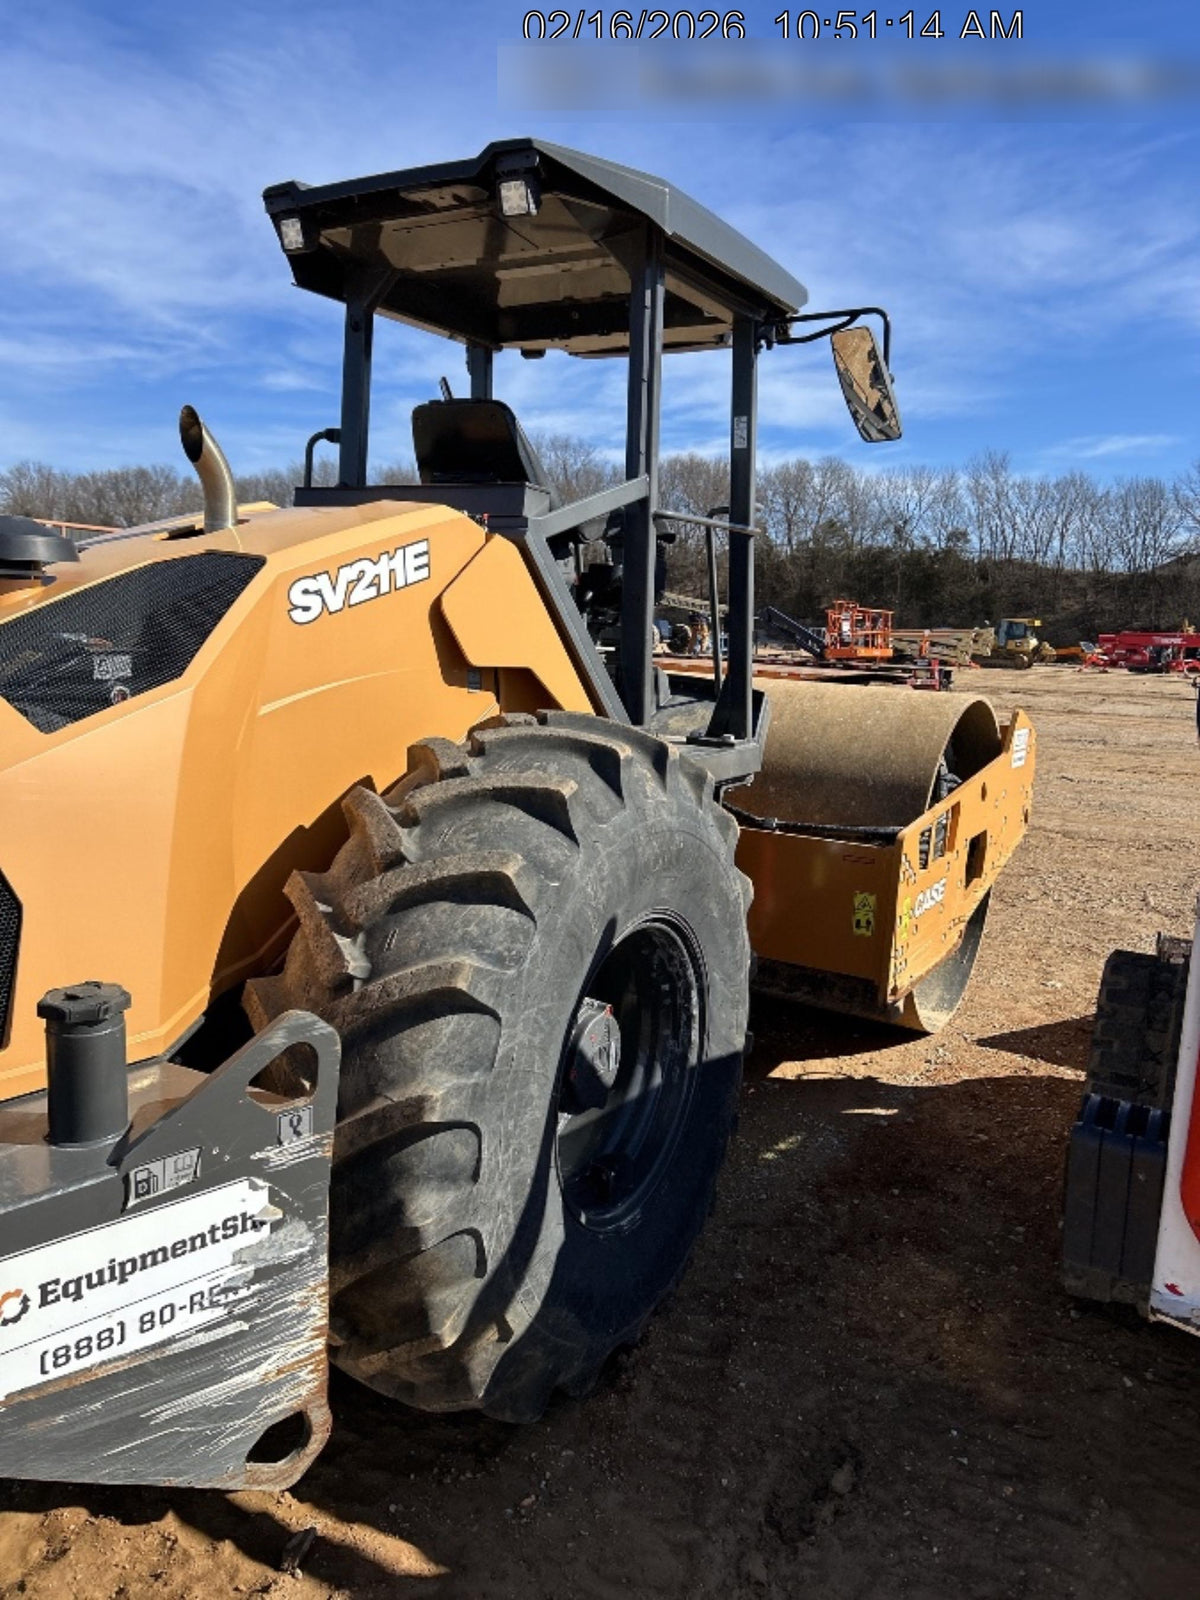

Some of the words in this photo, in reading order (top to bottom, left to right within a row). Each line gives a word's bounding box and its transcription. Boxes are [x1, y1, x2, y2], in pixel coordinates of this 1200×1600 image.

[287, 538, 431, 625] SV211E
[913, 876, 947, 918] CASE
[38, 1211, 267, 1309] EquipmentSh
[40, 1320, 126, 1375] (888)
